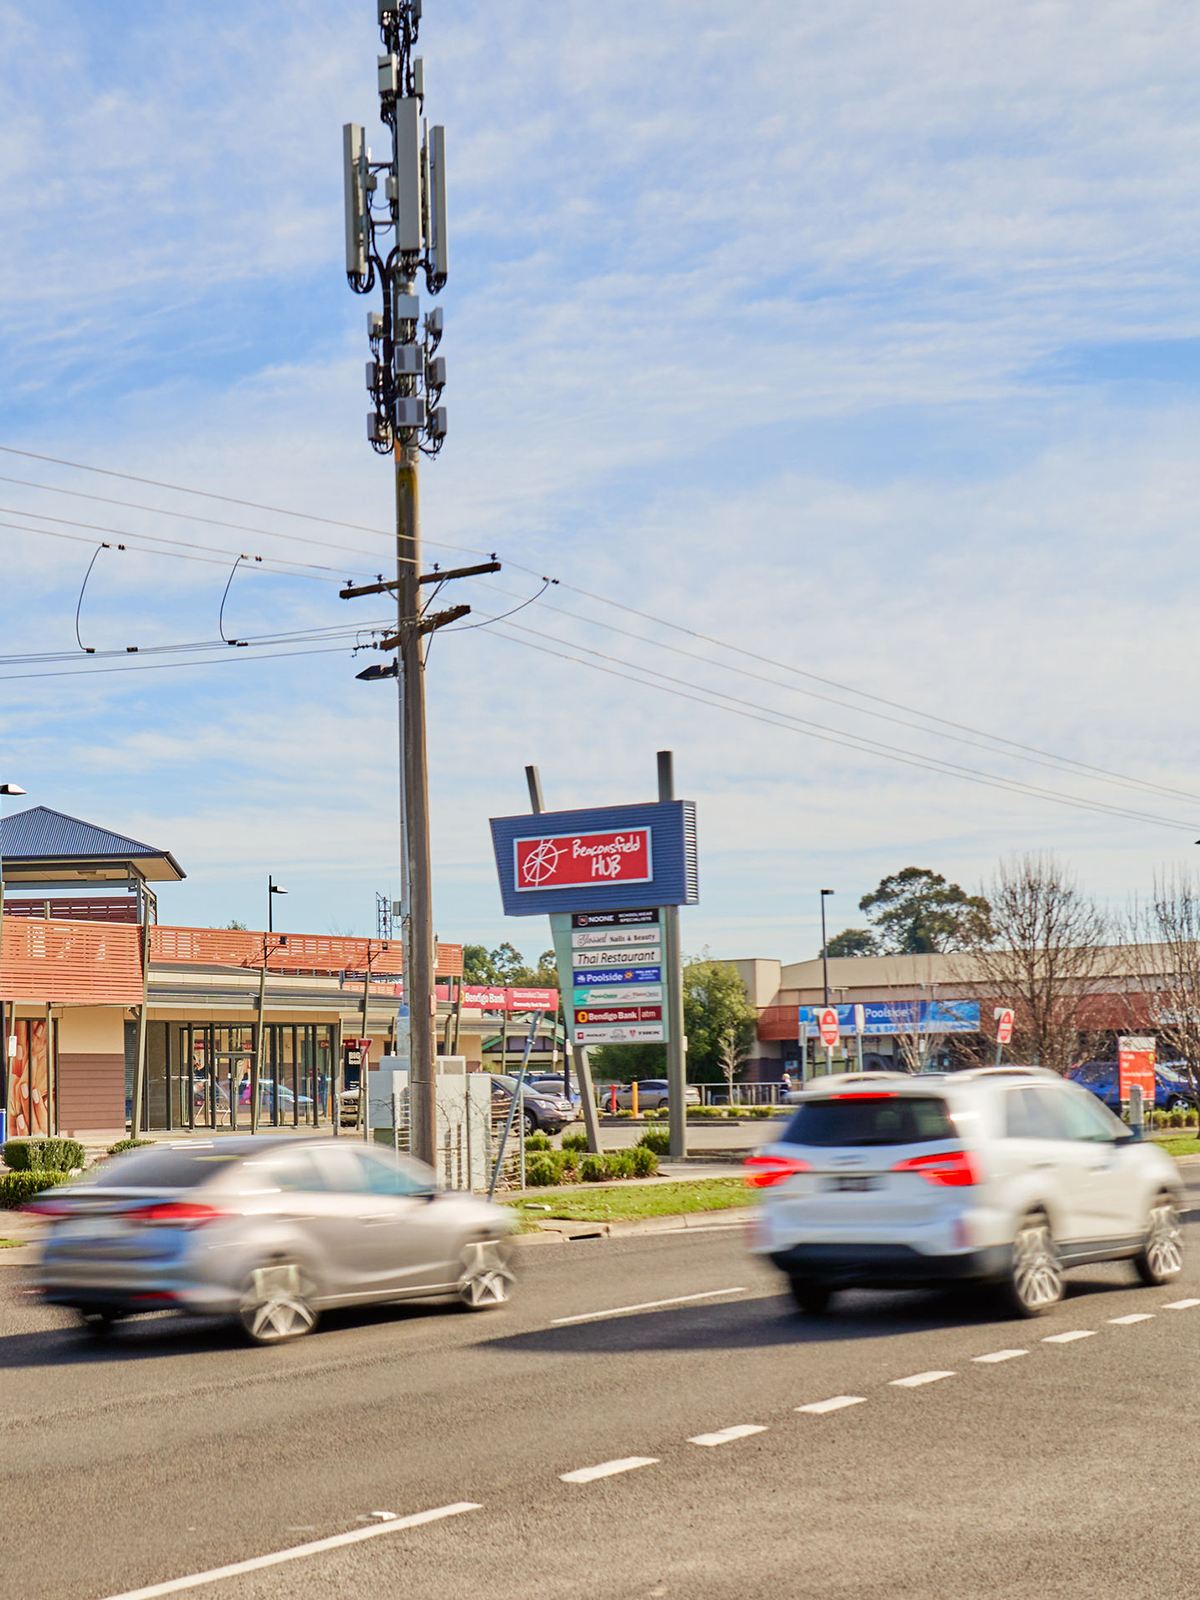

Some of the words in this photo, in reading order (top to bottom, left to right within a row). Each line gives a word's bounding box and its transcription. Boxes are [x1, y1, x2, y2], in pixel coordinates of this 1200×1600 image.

[572, 834, 641, 859] Beaconsfield
[588, 914, 615, 923] NOONE
[577, 953, 599, 965] Thai
[601, 951, 655, 963] Restaurant
[586, 972, 623, 982] Poolside
[465, 992, 489, 1005] Bendigo
[489, 994, 505, 1004] Bank
[588, 1012, 617, 1021] Bendigo
[618, 1011, 637, 1019] Bank
[641, 1010, 656, 1018] atm
[876, 1025, 882, 1033] &
